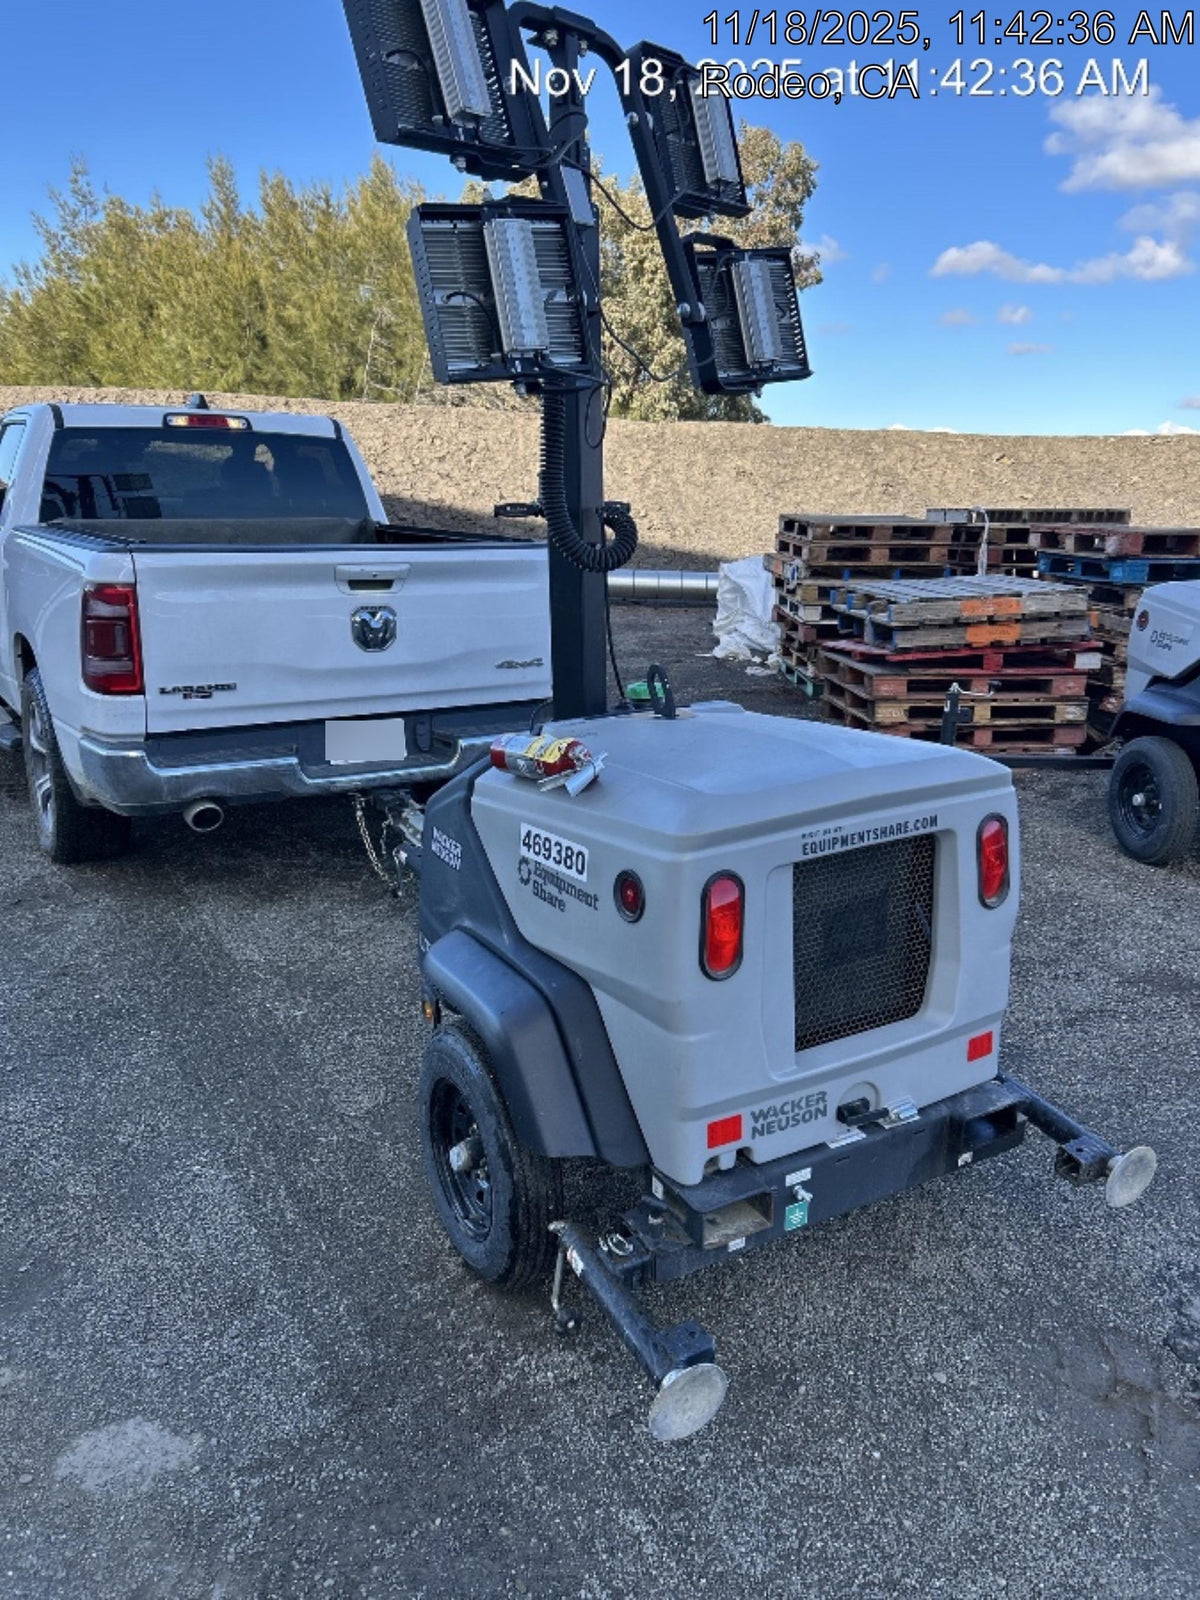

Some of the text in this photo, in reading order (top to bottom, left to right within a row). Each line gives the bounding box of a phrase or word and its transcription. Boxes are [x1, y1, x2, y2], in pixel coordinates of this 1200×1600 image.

[521, 829, 587, 876] 469380
[802, 813, 938, 856] EQUIPMENTSHARE.COM
[532, 860, 599, 912] Equipment
[532, 882, 566, 913] Share
[750, 1090, 828, 1125] WACKER
[751, 1103, 828, 1140] NEUSON
